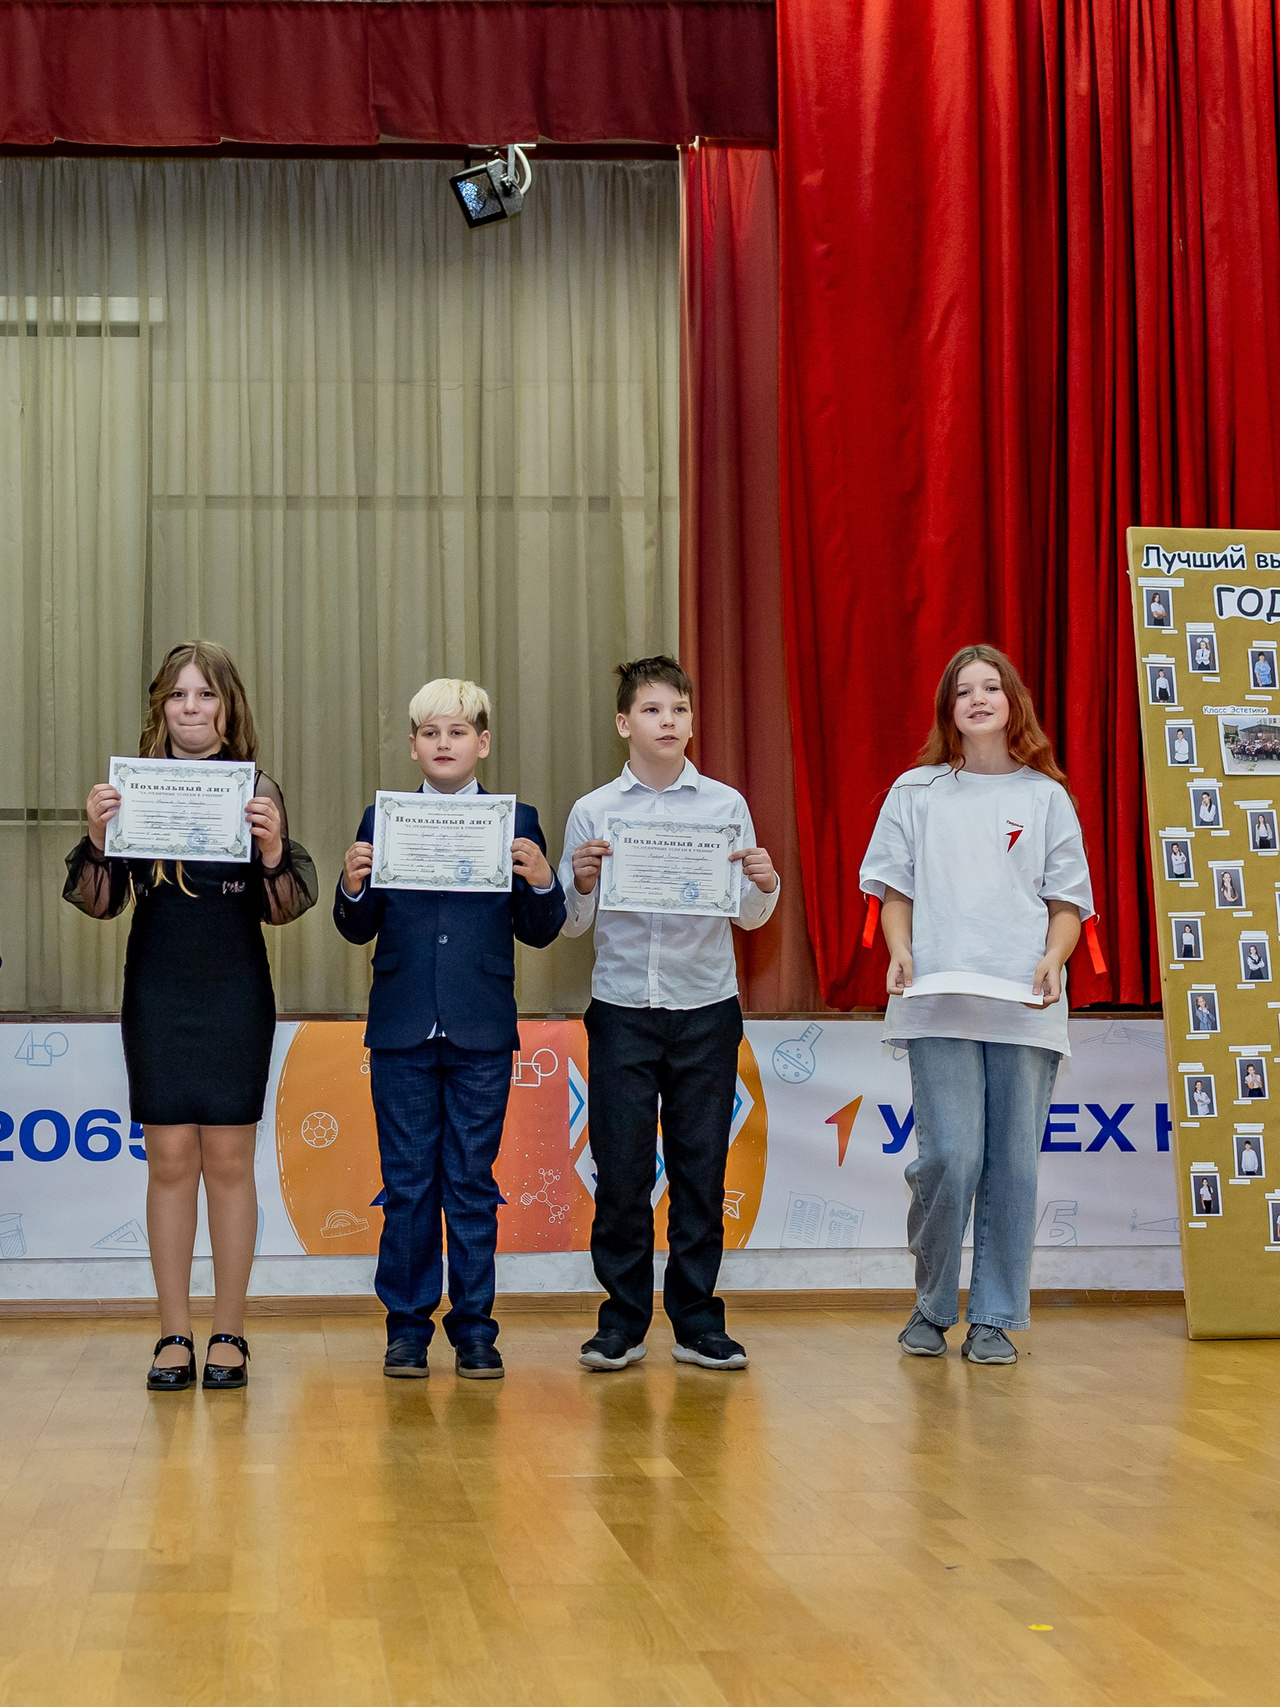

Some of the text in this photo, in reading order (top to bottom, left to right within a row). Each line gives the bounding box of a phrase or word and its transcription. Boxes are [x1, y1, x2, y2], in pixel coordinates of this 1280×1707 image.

[1143, 545, 1245, 574] Лучший
[1203, 706, 1267, 714] Класс Эстетики
[877, 1102, 1137, 1153] УЕХ
